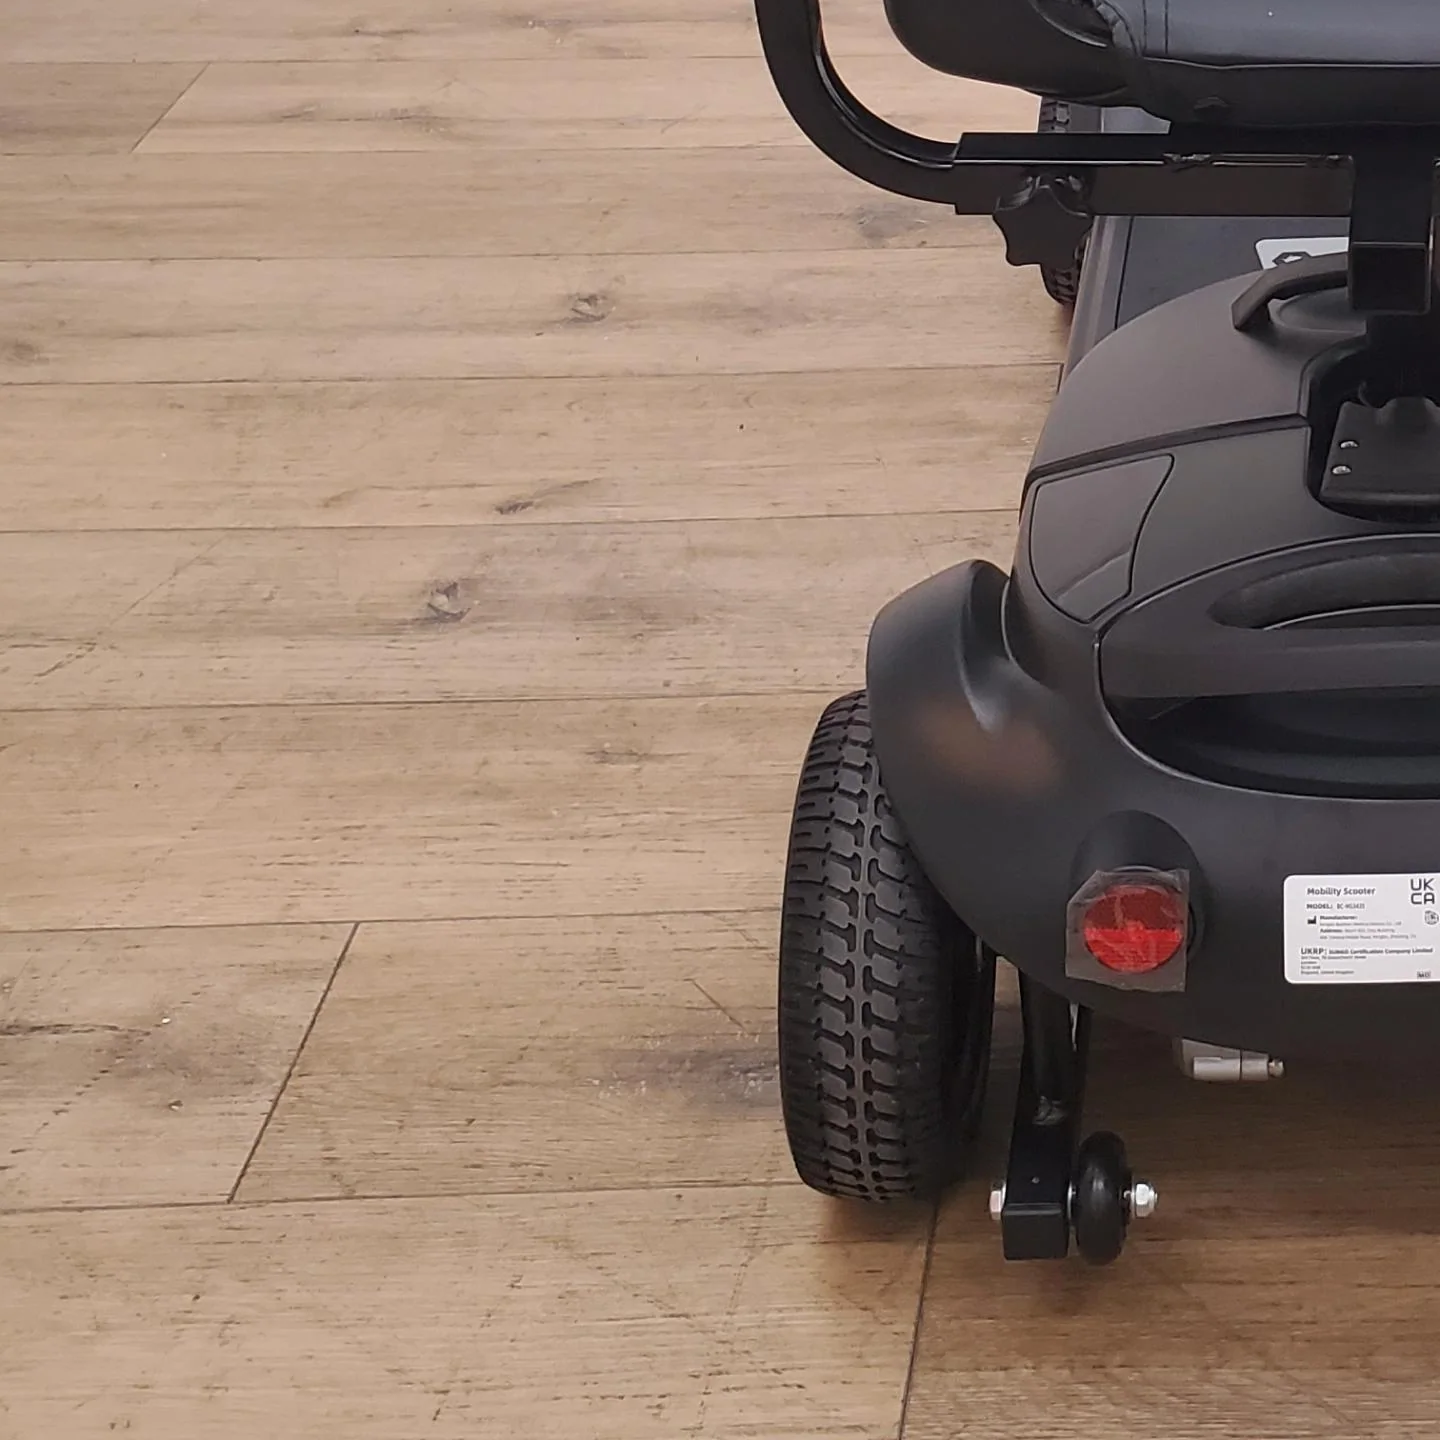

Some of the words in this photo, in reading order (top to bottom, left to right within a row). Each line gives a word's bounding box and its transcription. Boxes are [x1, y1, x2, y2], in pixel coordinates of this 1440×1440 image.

[1410, 878, 1434, 891] UK
[1307, 887, 1341, 896] Mobility
[1343, 887, 1376, 895] Scooter
[1410, 892, 1435, 905] CA
